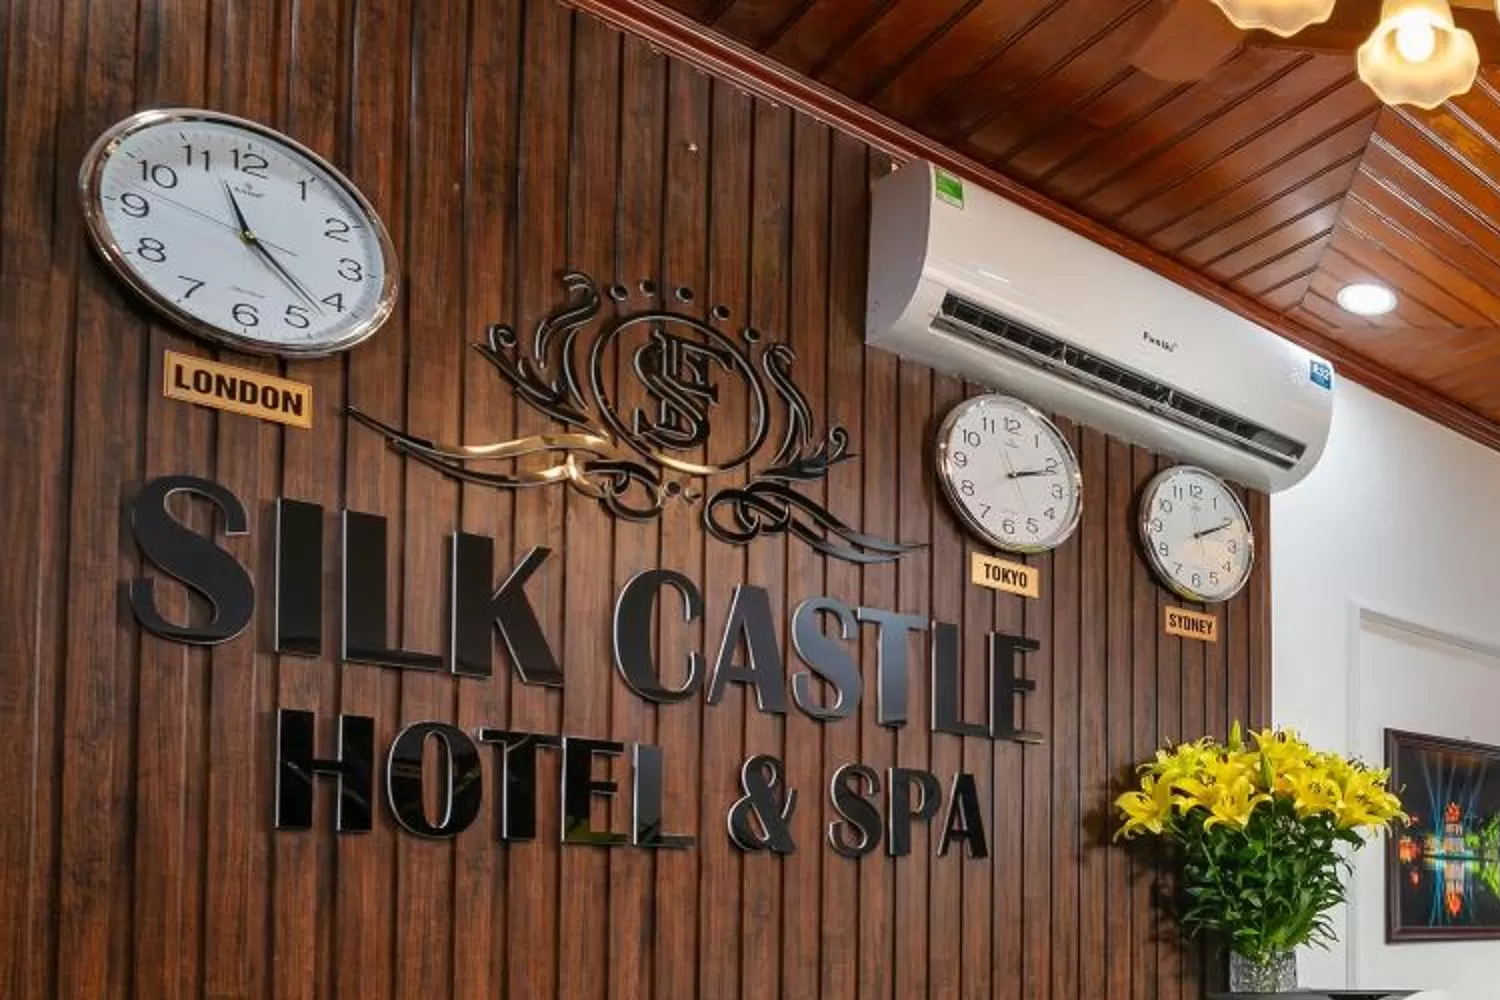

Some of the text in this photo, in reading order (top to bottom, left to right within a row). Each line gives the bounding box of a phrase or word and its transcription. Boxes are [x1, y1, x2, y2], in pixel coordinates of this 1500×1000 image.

[182, 143, 211, 172] 11
[230, 148, 269, 179] 12
[138, 159, 178, 189] 10
[297, 179, 307, 201] 1
[120, 192, 149, 218] 9
[324, 217, 350, 242] 2
[137, 237, 166, 263] 8
[337, 257, 363, 283] 3
[178, 274, 205, 299] 7
[321, 292, 344, 313] 4
[232, 303, 259, 327] 6
[284, 304, 310, 329] 5
[174, 364, 303, 416] LONDON
[982, 416, 995, 435] 11
[1003, 416, 1022, 437] 12
[963, 428, 981, 448] 10
[1034, 434, 1039, 449] 1
[954, 451, 967, 468] 9
[1045, 457, 1058, 474] 2
[961, 479, 975, 497] 8
[1052, 483, 1063, 500] 3
[979, 502, 991, 519] 7
[1044, 507, 1056, 520] 4
[1002, 518, 1015, 534] 6
[1026, 517, 1039, 534] 5
[983, 562, 1028, 589] TOKYO
[128, 475, 1044, 743] SILK CASTLE
[1168, 612, 1213, 636] SYDNEY
[274, 708, 990, 860] HOTEL & SPA
